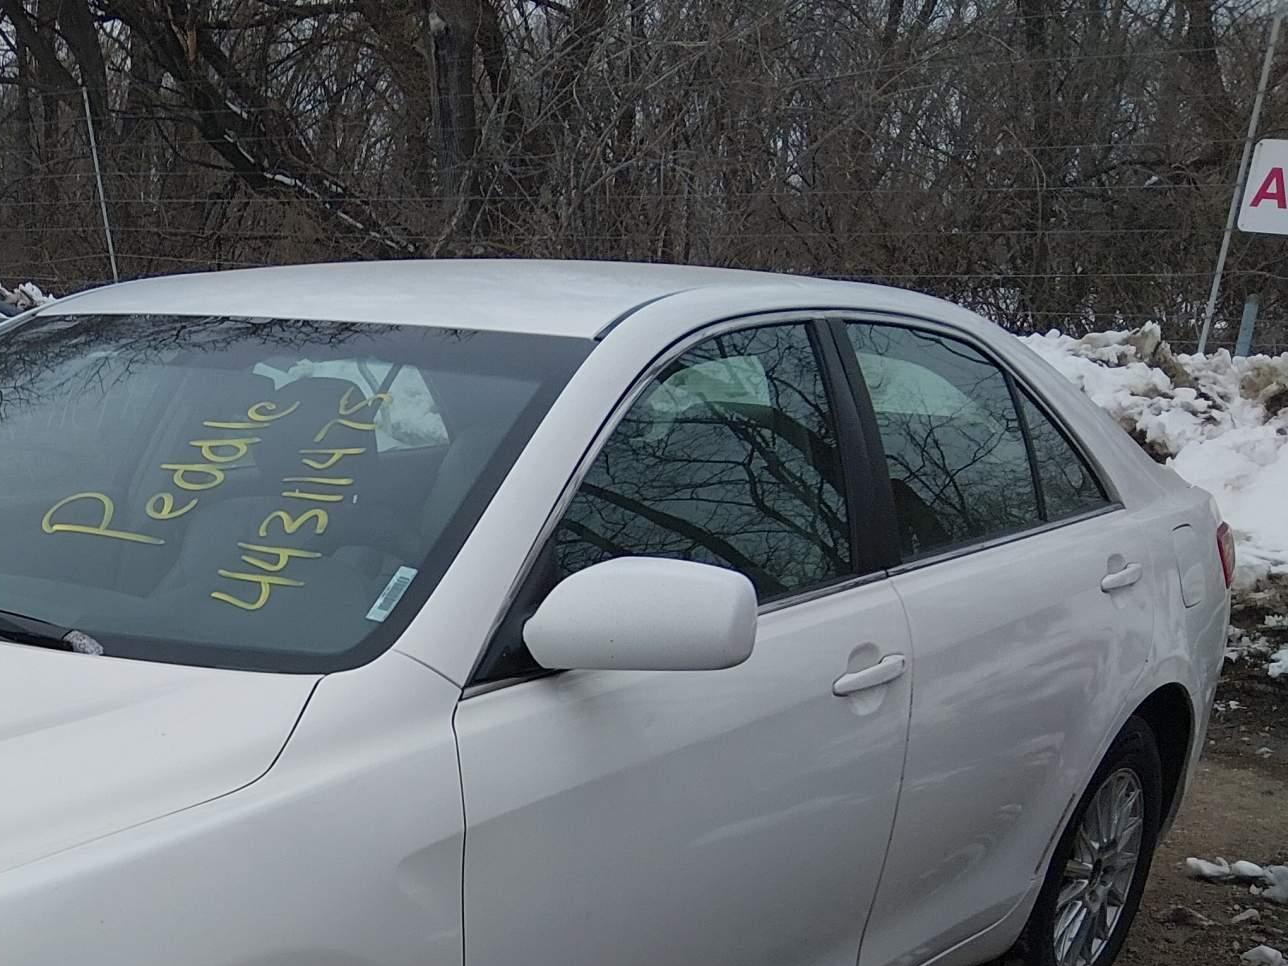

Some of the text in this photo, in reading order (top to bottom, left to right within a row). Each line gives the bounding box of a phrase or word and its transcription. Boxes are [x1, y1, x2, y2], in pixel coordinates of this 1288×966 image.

[1250, 167, 1288, 209] A
[41, 400, 301, 545] Peddle
[210, 386, 394, 611] 44311475
